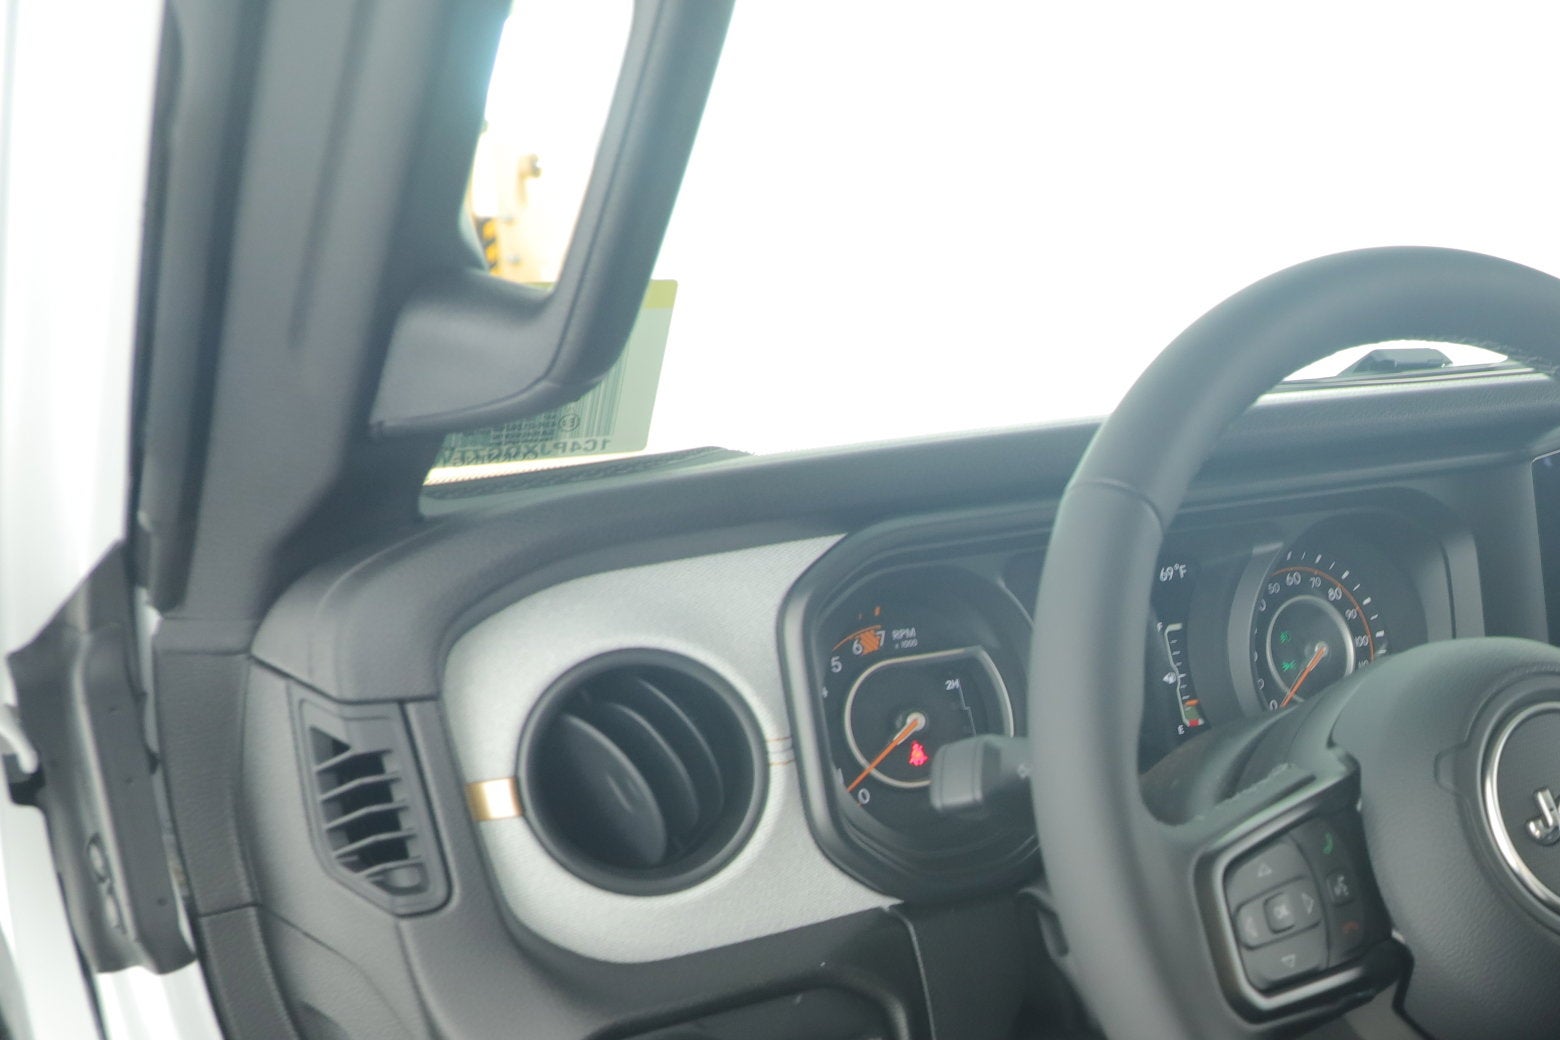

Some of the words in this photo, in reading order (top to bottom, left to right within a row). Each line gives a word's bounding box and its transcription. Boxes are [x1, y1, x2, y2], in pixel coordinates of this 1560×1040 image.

[1286, 572, 1301, 586] 60
[1310, 576, 1321, 588] 70
[1268, 583, 1280, 595] 50
[1328, 587, 1342, 601] 80
[1345, 608, 1358, 620] 90
[876, 630, 886, 647] 7
[892, 627, 916, 640] RPM
[852, 639, 863, 655] 6
[1354, 635, 1369, 647] 100
[831, 656, 842, 673] 5
[857, 788, 870, 805] 0
